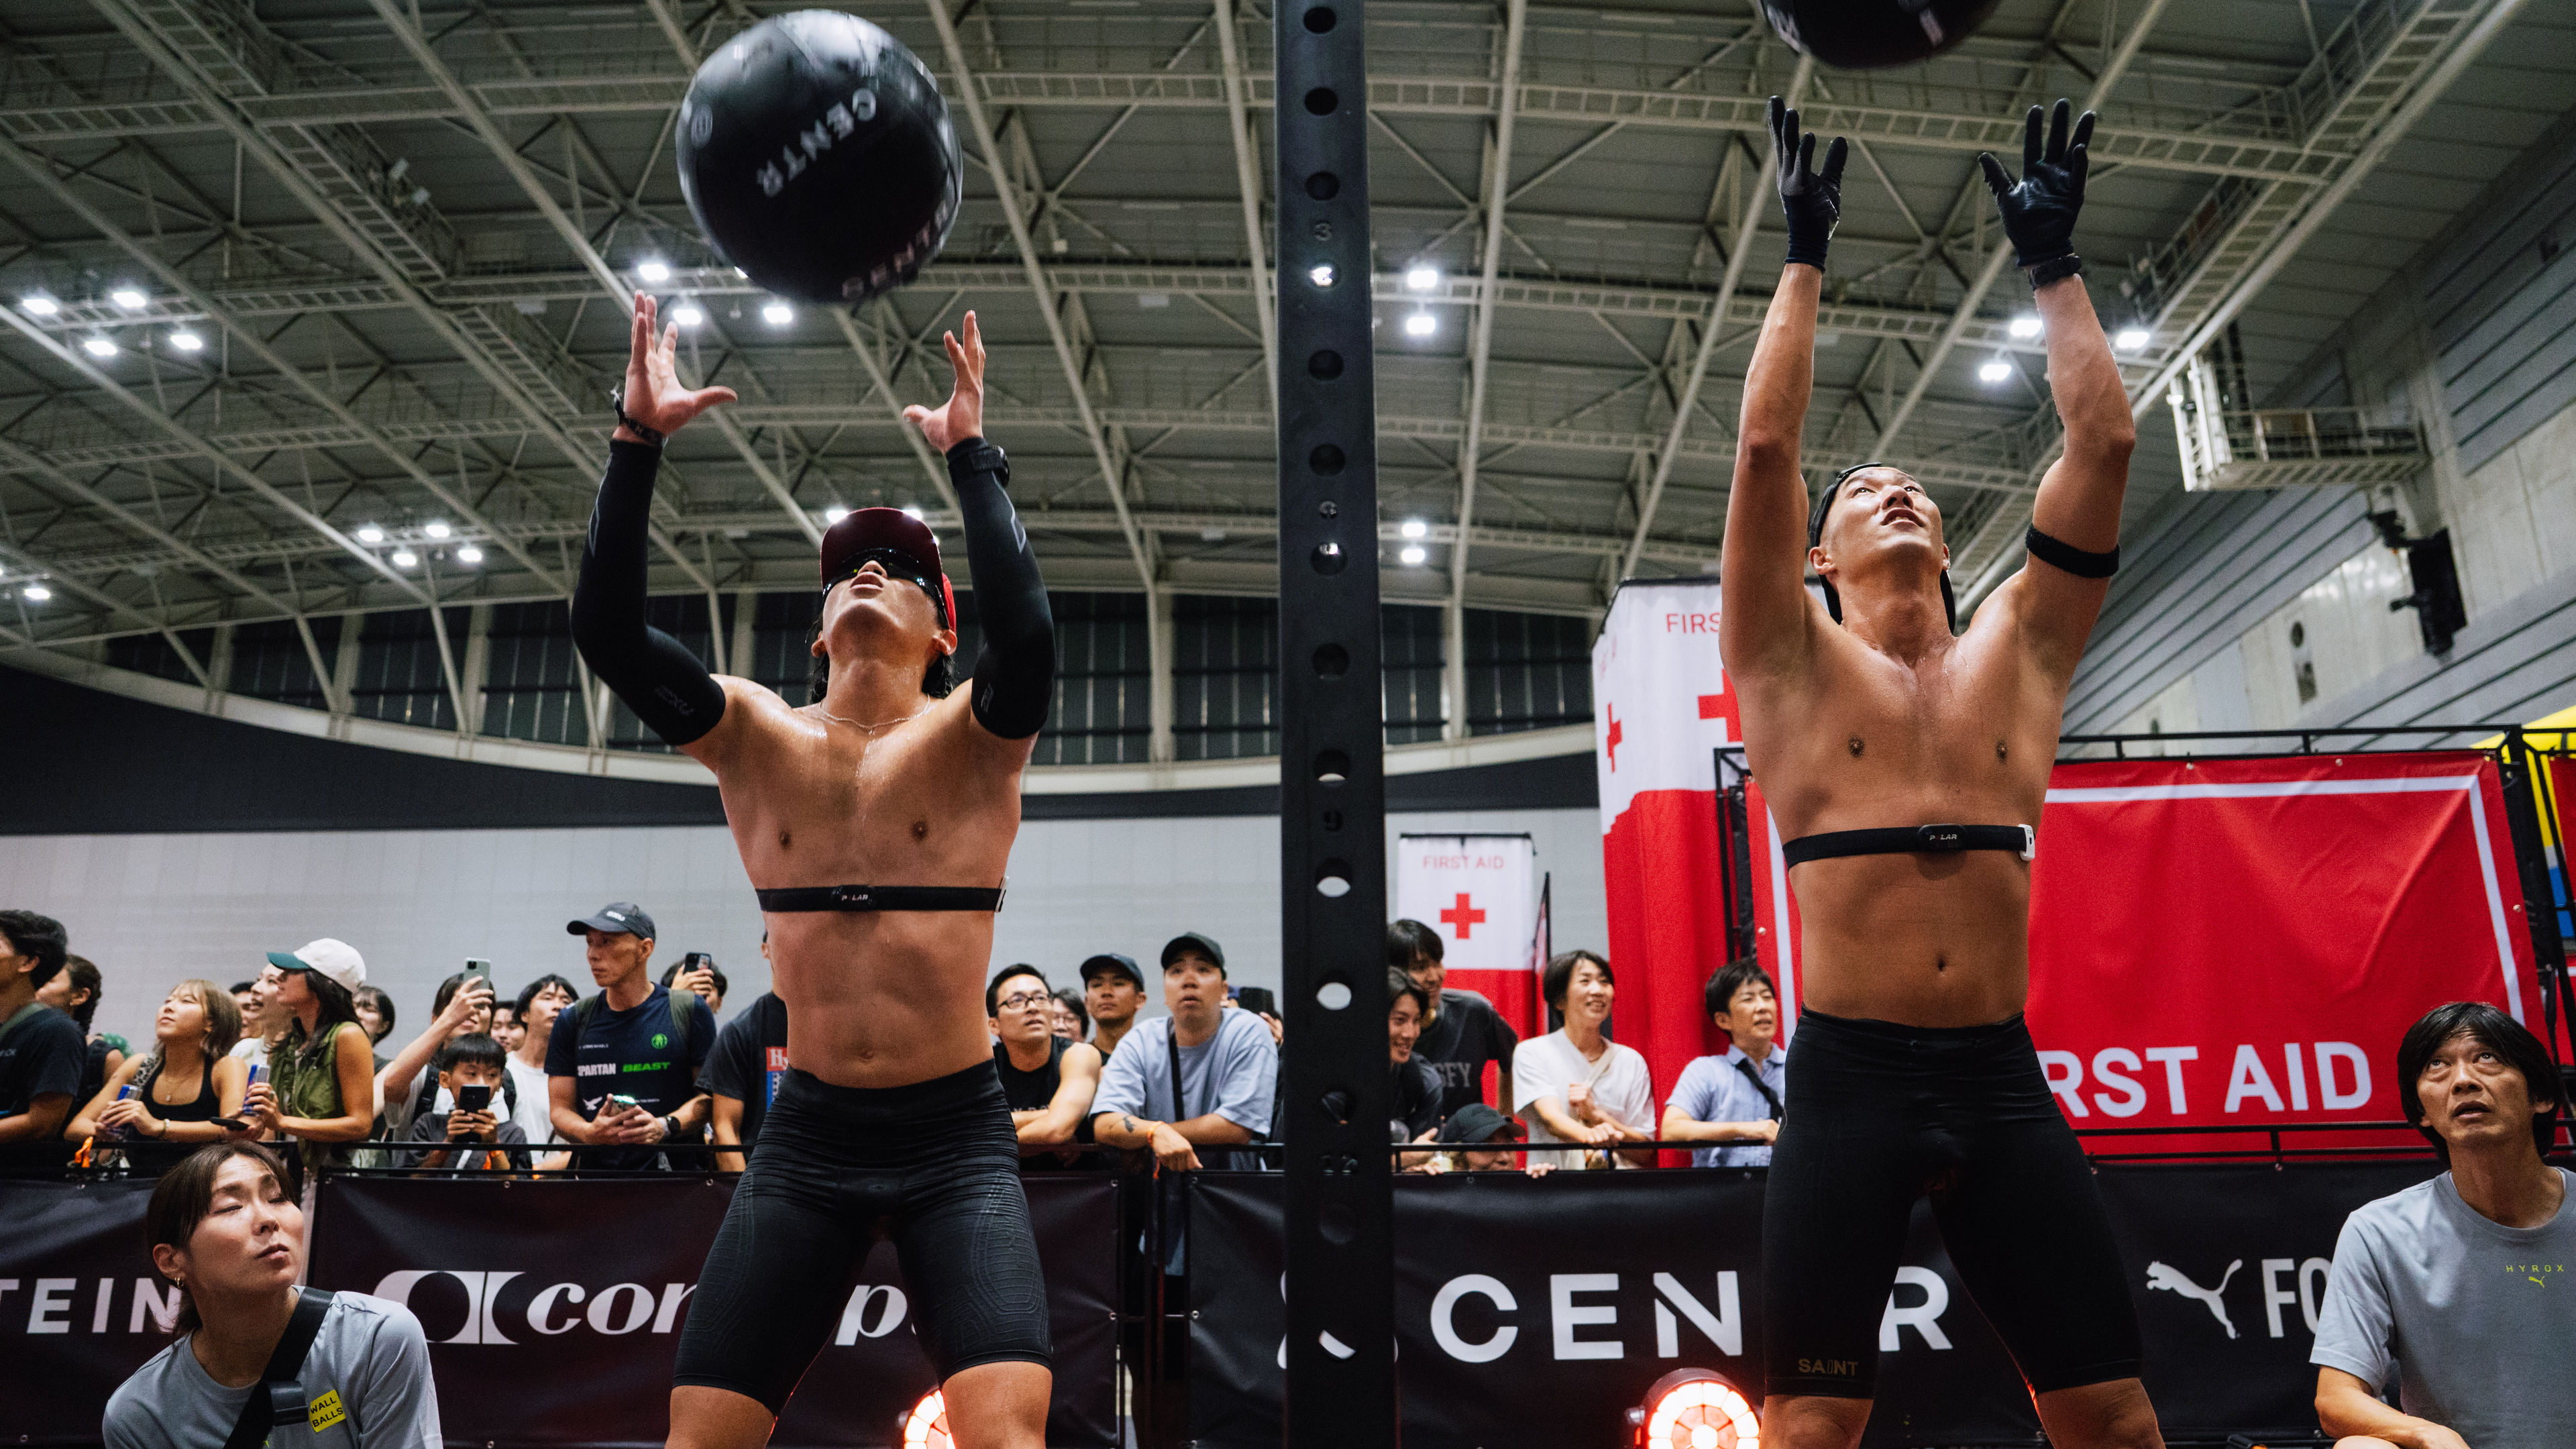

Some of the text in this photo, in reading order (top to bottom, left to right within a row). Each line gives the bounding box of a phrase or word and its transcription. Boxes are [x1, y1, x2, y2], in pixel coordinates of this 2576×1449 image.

[1314, 223, 1332, 241] 3
[1666, 612, 1720, 633] FIRS
[1423, 855, 1505, 869] FIRST AID
[578, 1062, 671, 1076] SPARTAN BEAST
[2035, 1041, 2373, 1118] RST AID
[2506, 1265, 2564, 1273] HYROX
[1430, 1266, 1953, 1363] CENR
[311, 1397, 337, 1413] WALL
[312, 1407, 343, 1427] BALLS
